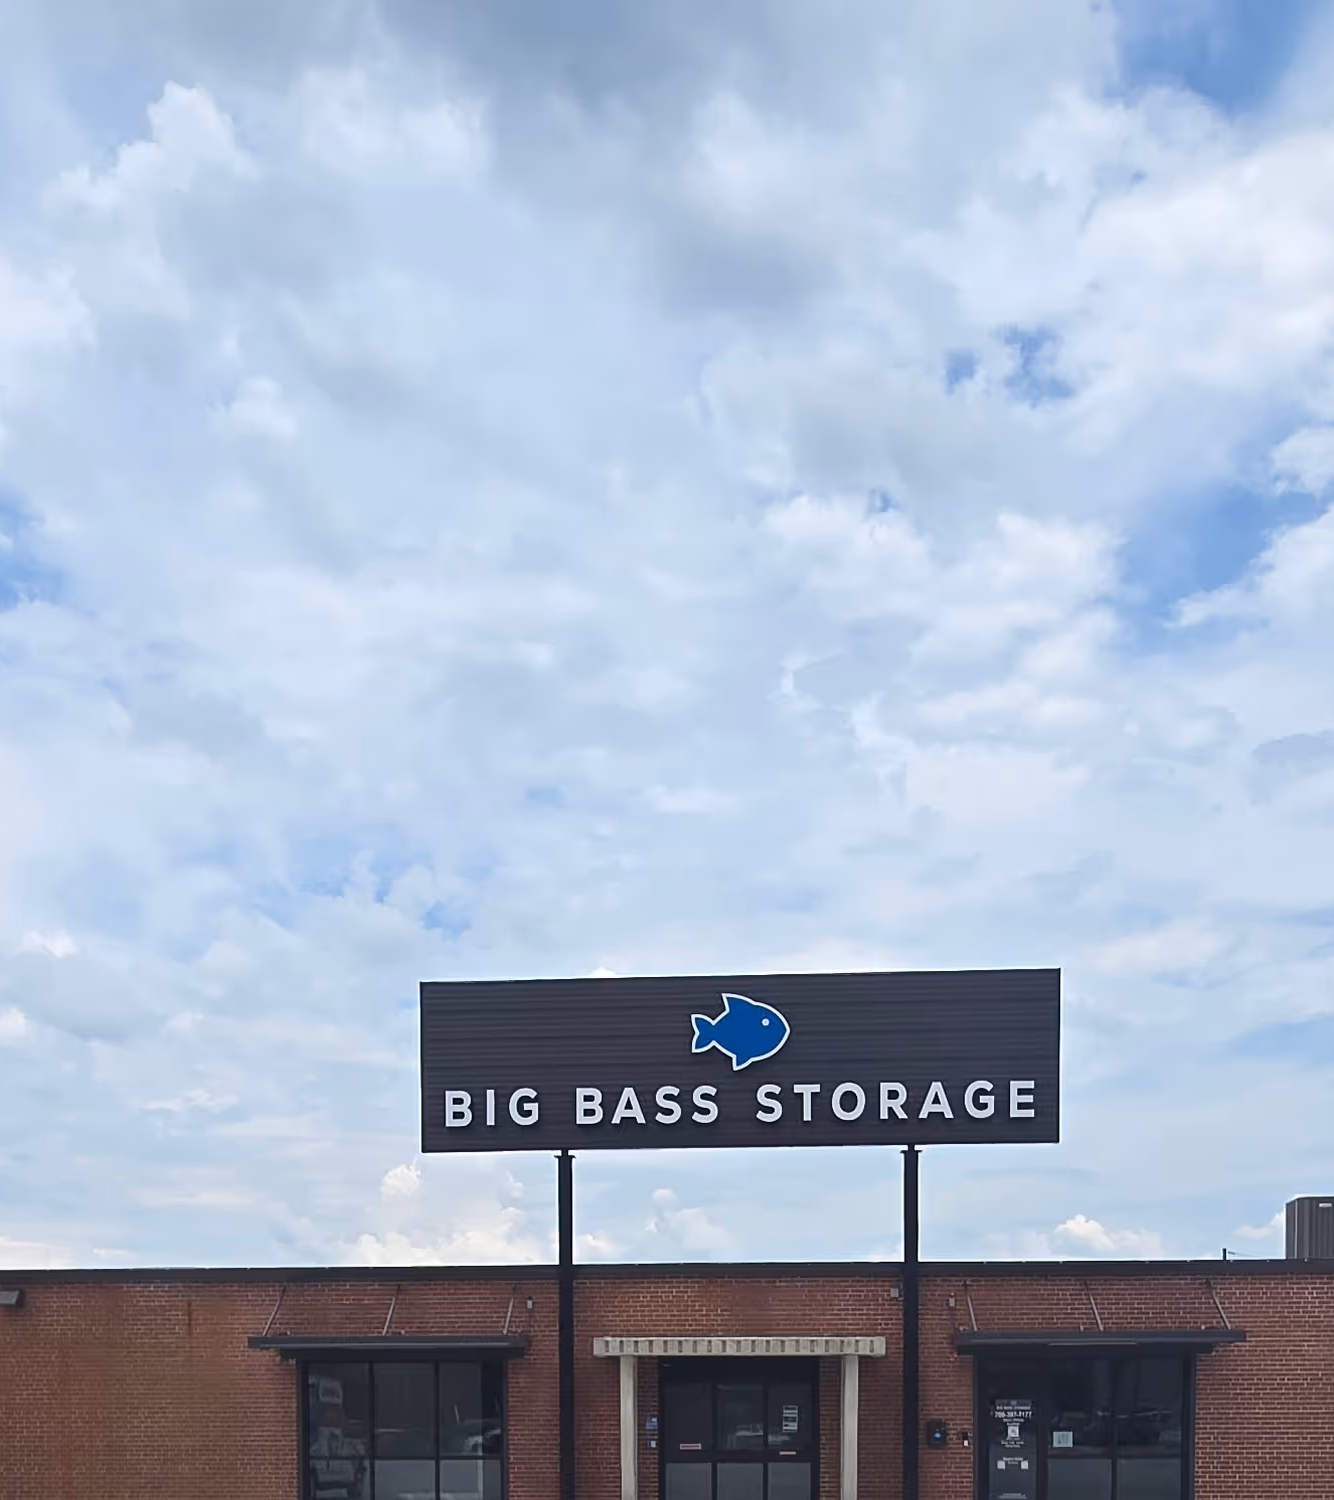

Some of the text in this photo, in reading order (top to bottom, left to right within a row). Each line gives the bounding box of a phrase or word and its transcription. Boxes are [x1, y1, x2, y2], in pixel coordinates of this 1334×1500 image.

[444, 1080, 1036, 1127] BIG BASS STORAGE
